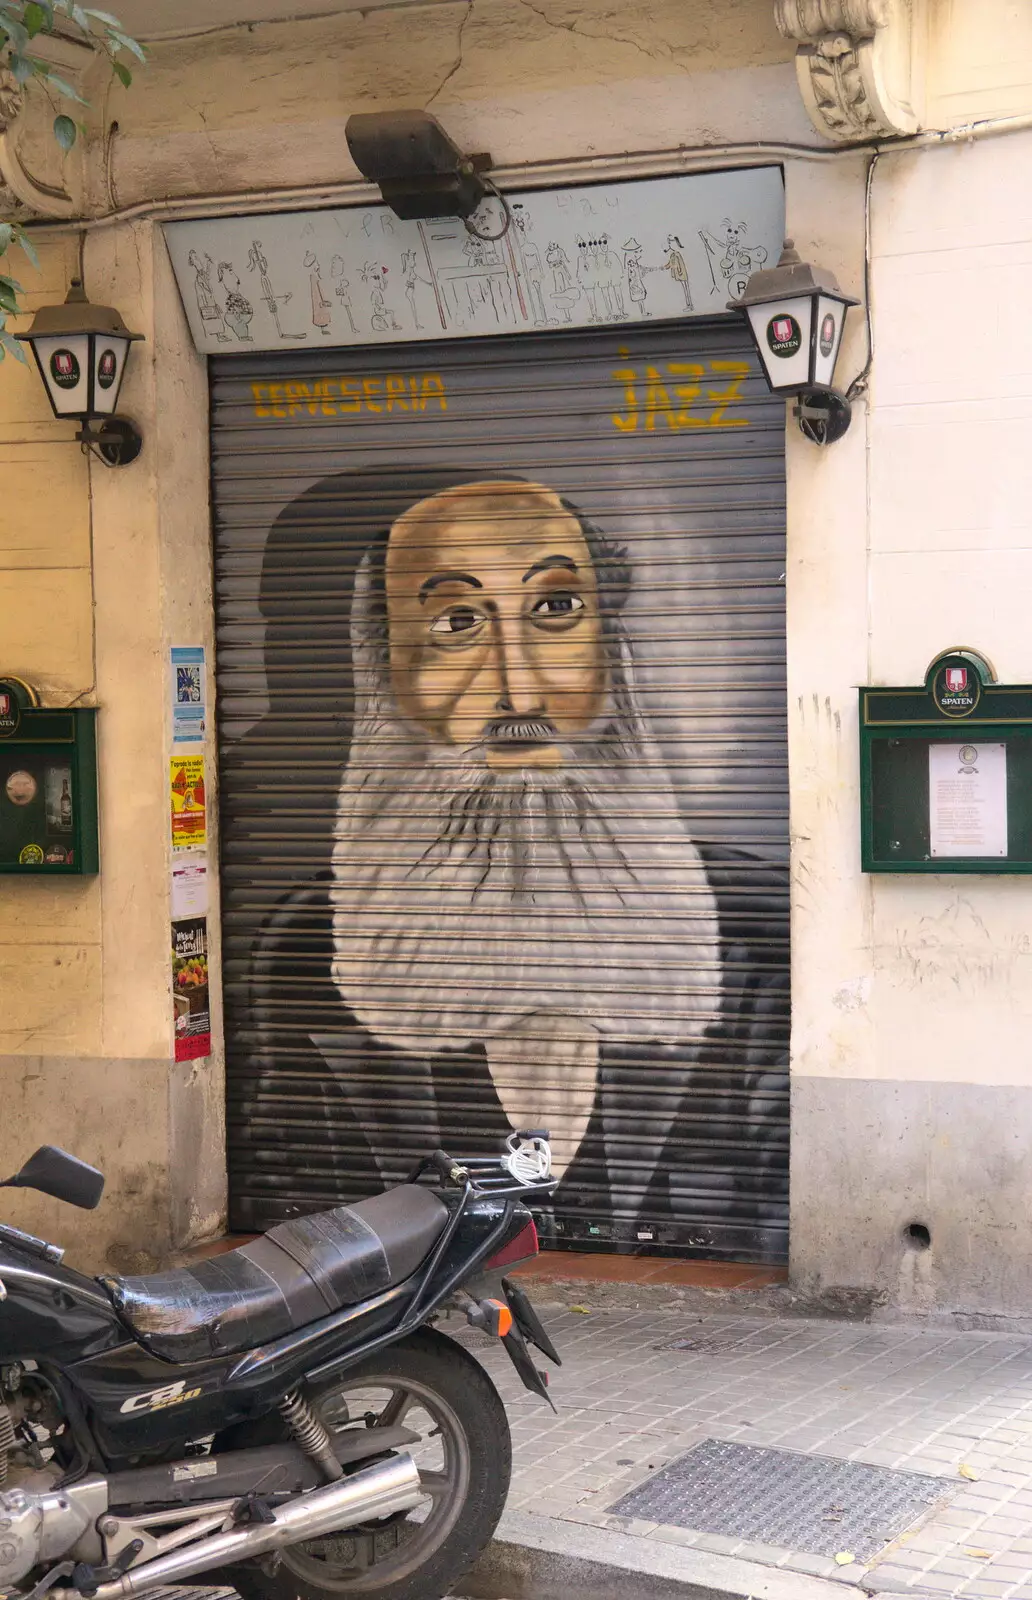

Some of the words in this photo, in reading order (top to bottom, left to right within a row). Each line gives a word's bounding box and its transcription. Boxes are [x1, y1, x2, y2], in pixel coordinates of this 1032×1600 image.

[772, 340, 799, 350] SPATEN
[941, 697, 973, 705] SPATEN
[120, 1380, 186, 1413] CB
